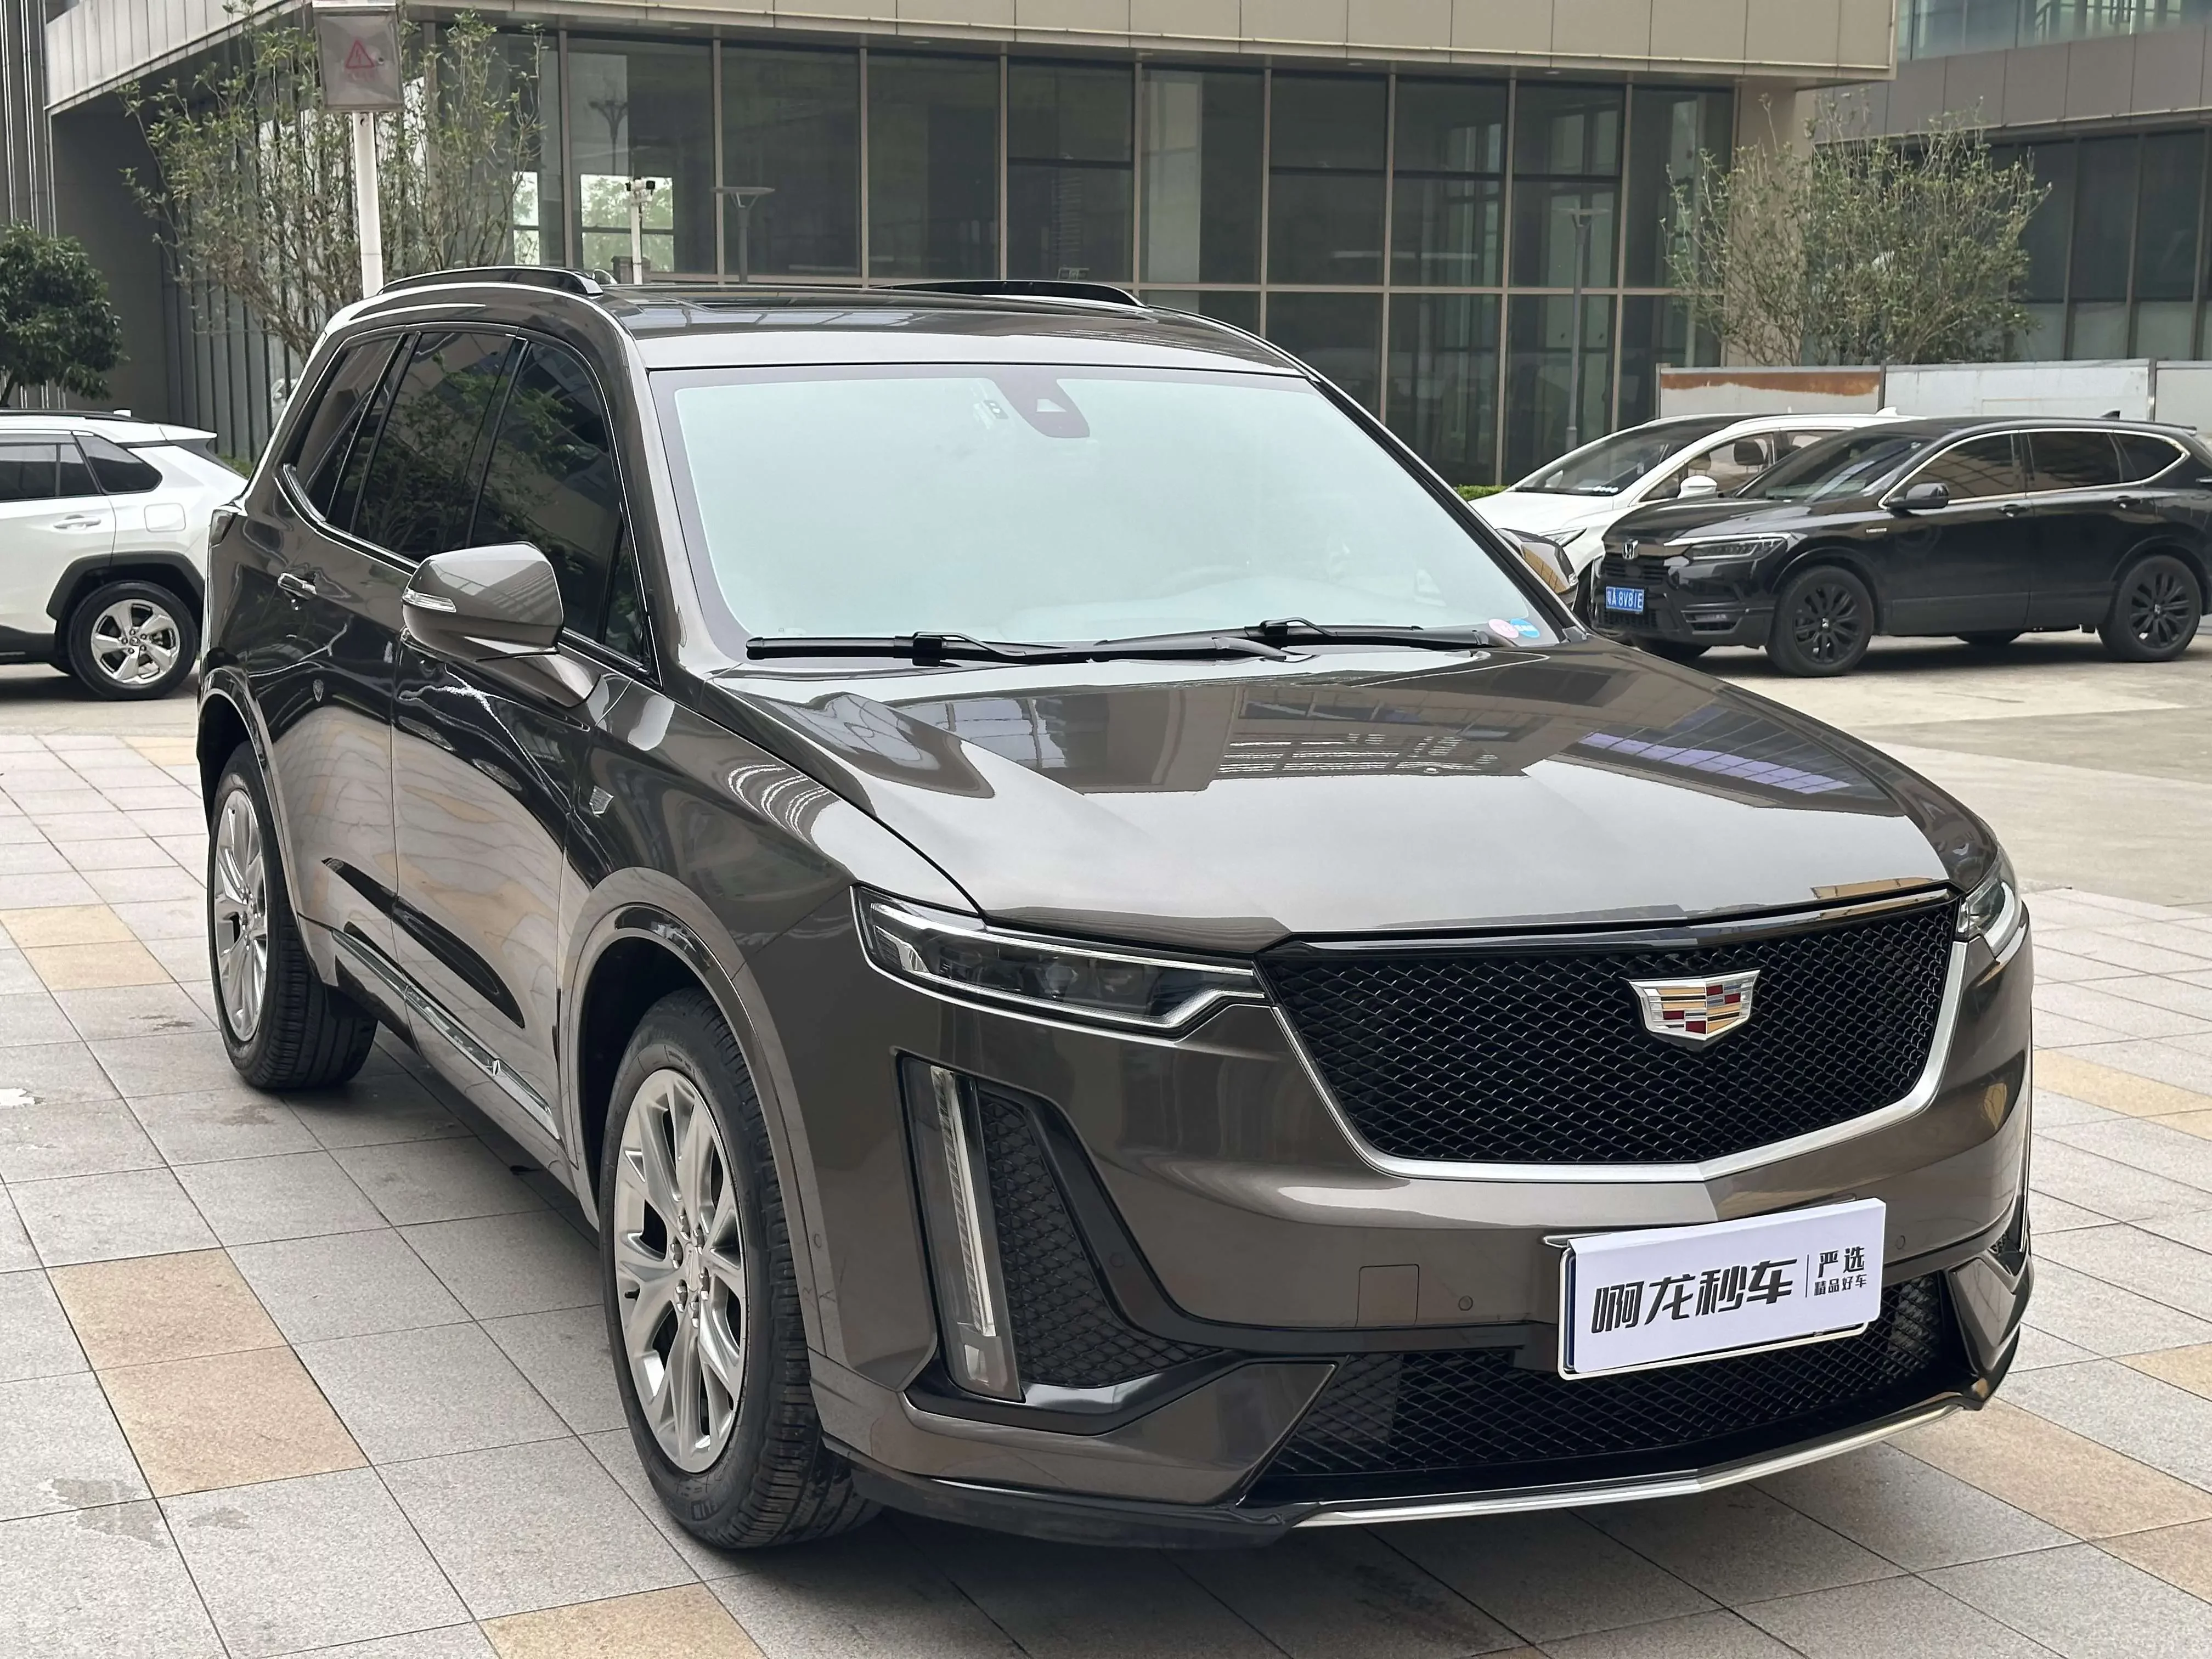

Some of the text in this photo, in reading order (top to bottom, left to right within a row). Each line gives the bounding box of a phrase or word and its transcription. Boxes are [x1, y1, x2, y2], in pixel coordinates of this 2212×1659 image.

[1818, 1246, 1865, 1278] 严选
[1591, 1259, 1798, 1333] 啊龙秒车
[1814, 1273, 1867, 1296] 精品好车
